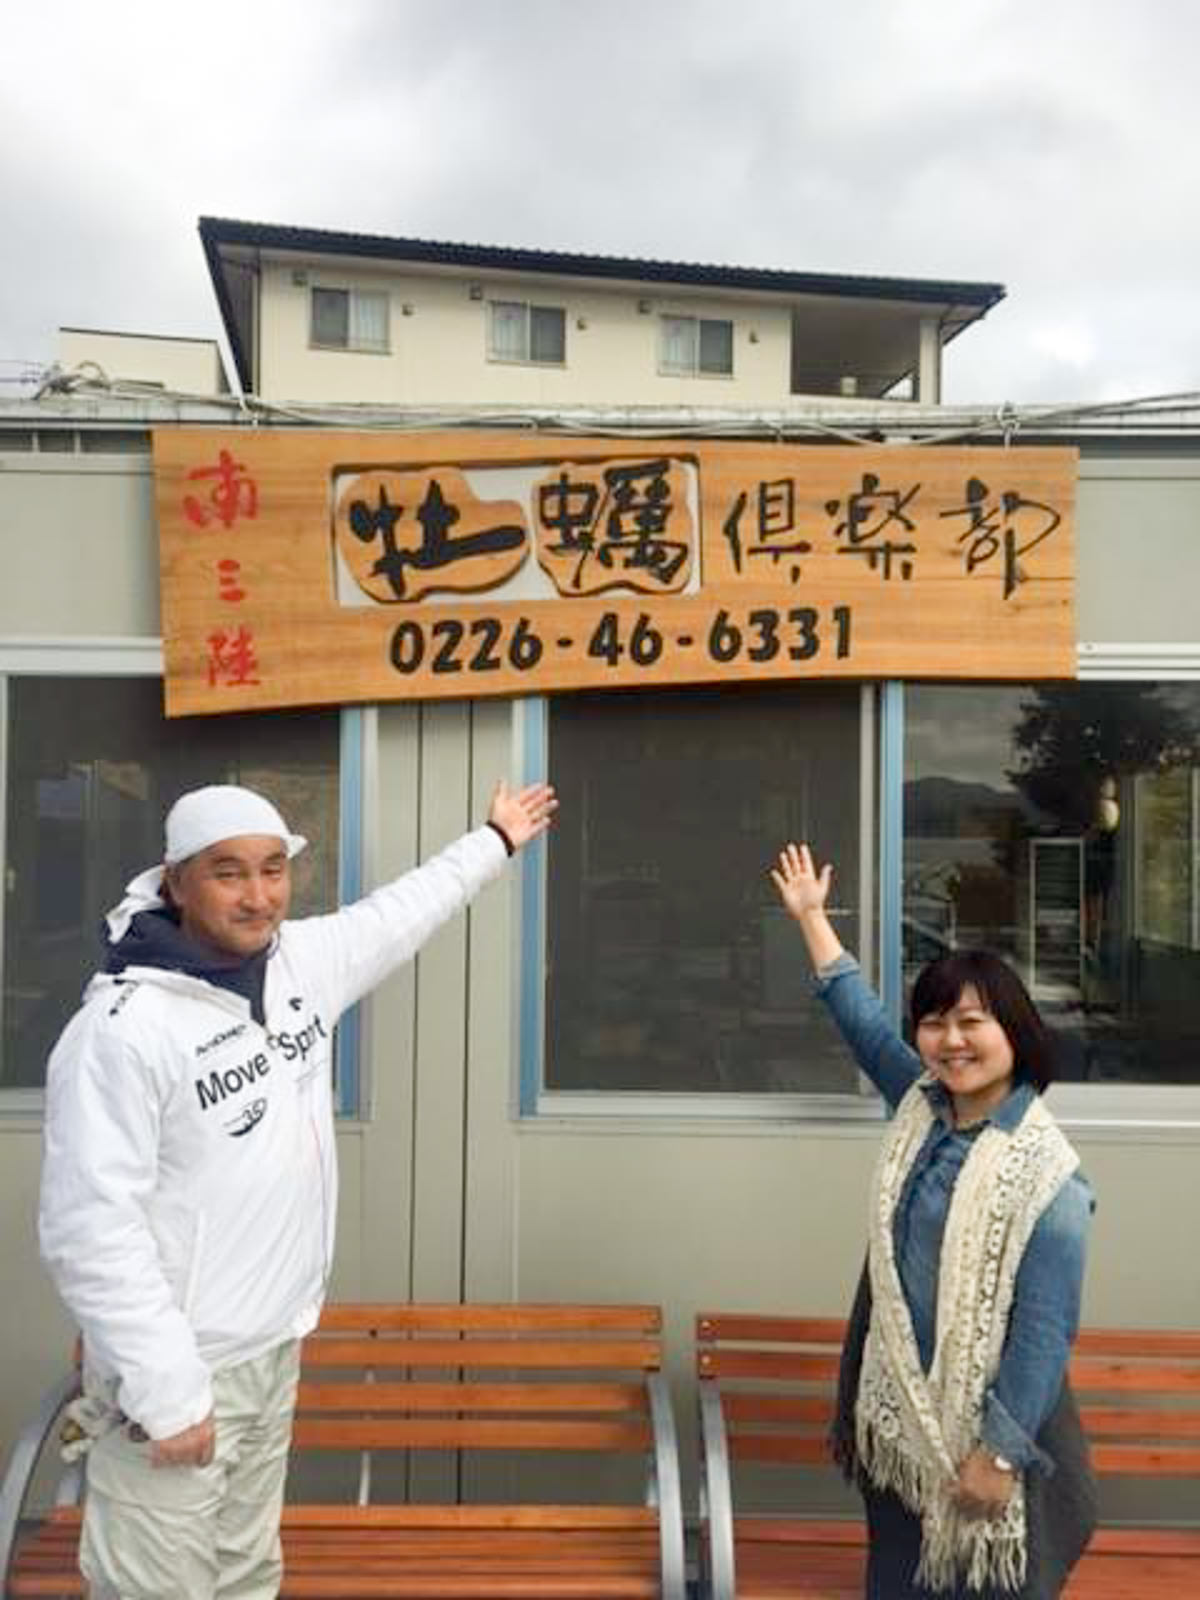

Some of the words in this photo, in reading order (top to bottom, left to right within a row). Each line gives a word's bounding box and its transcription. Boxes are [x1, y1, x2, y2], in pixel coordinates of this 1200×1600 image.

[184, 449, 260, 687] 南三陸
[389, 606, 852, 675] 0226-46-6331
[195, 1052, 270, 1111] Move
